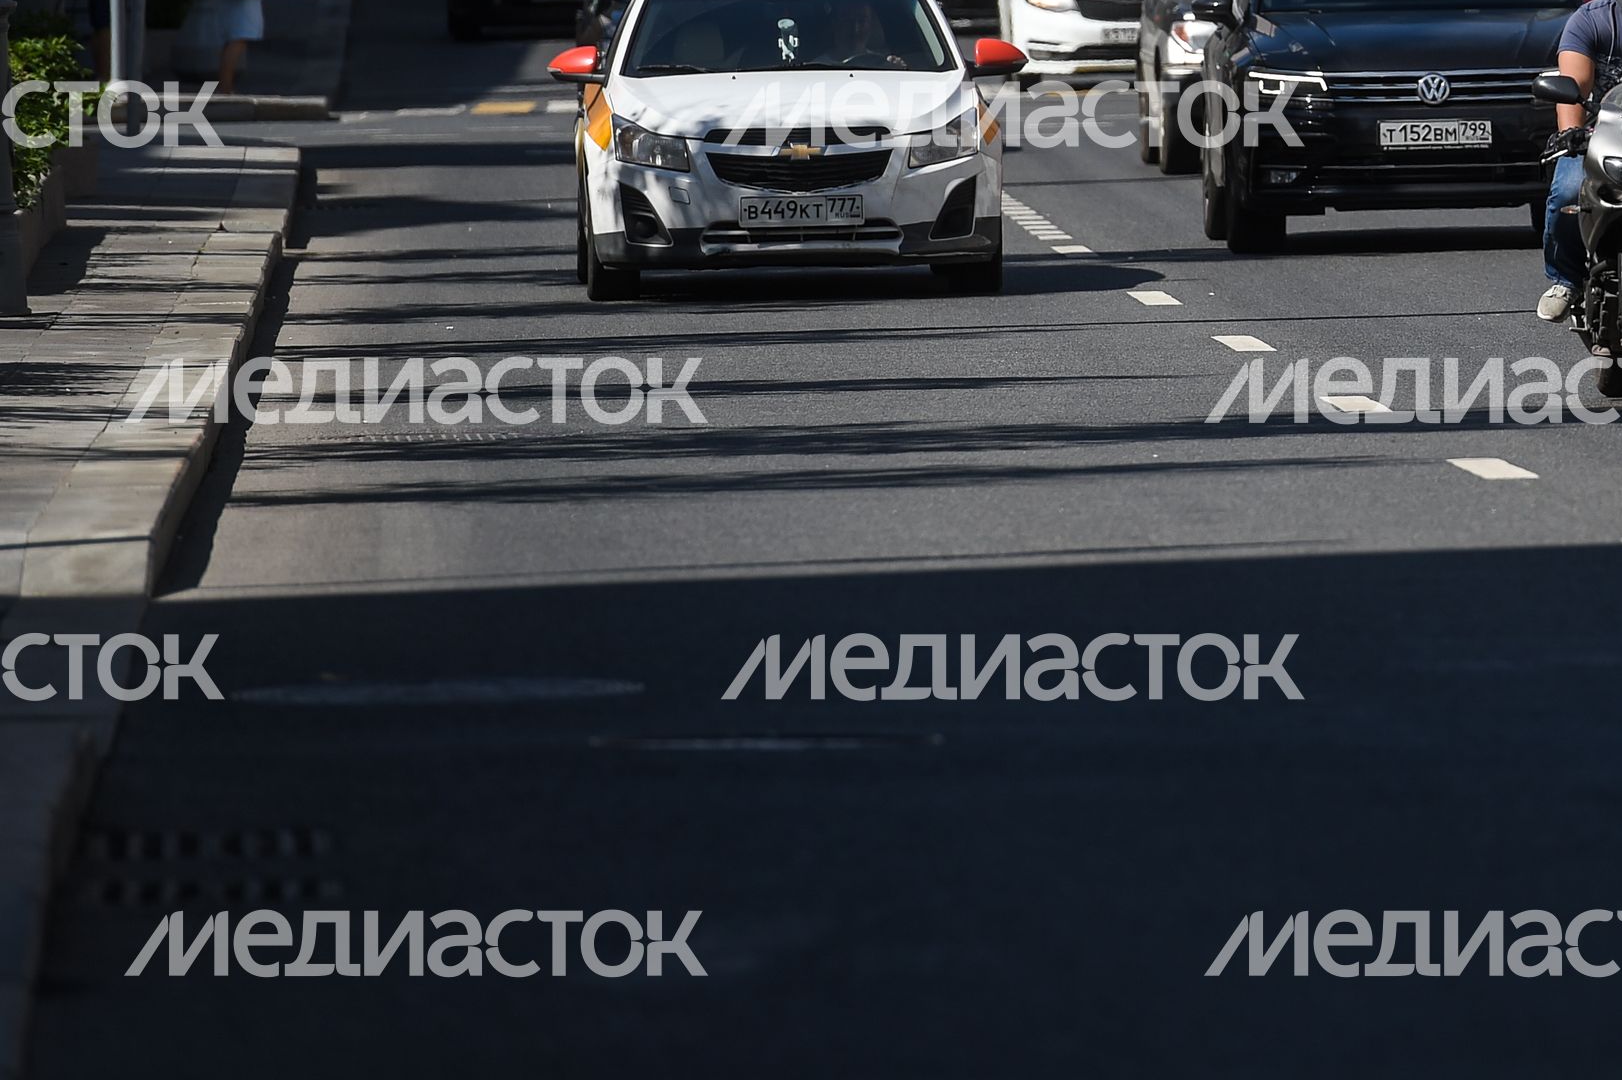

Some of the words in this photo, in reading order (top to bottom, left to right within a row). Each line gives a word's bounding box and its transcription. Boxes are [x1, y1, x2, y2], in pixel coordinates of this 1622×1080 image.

[1460, 122, 1487, 136] 799
[747, 200, 823, 220] В449КТ
[827, 198, 857, 213] 777
